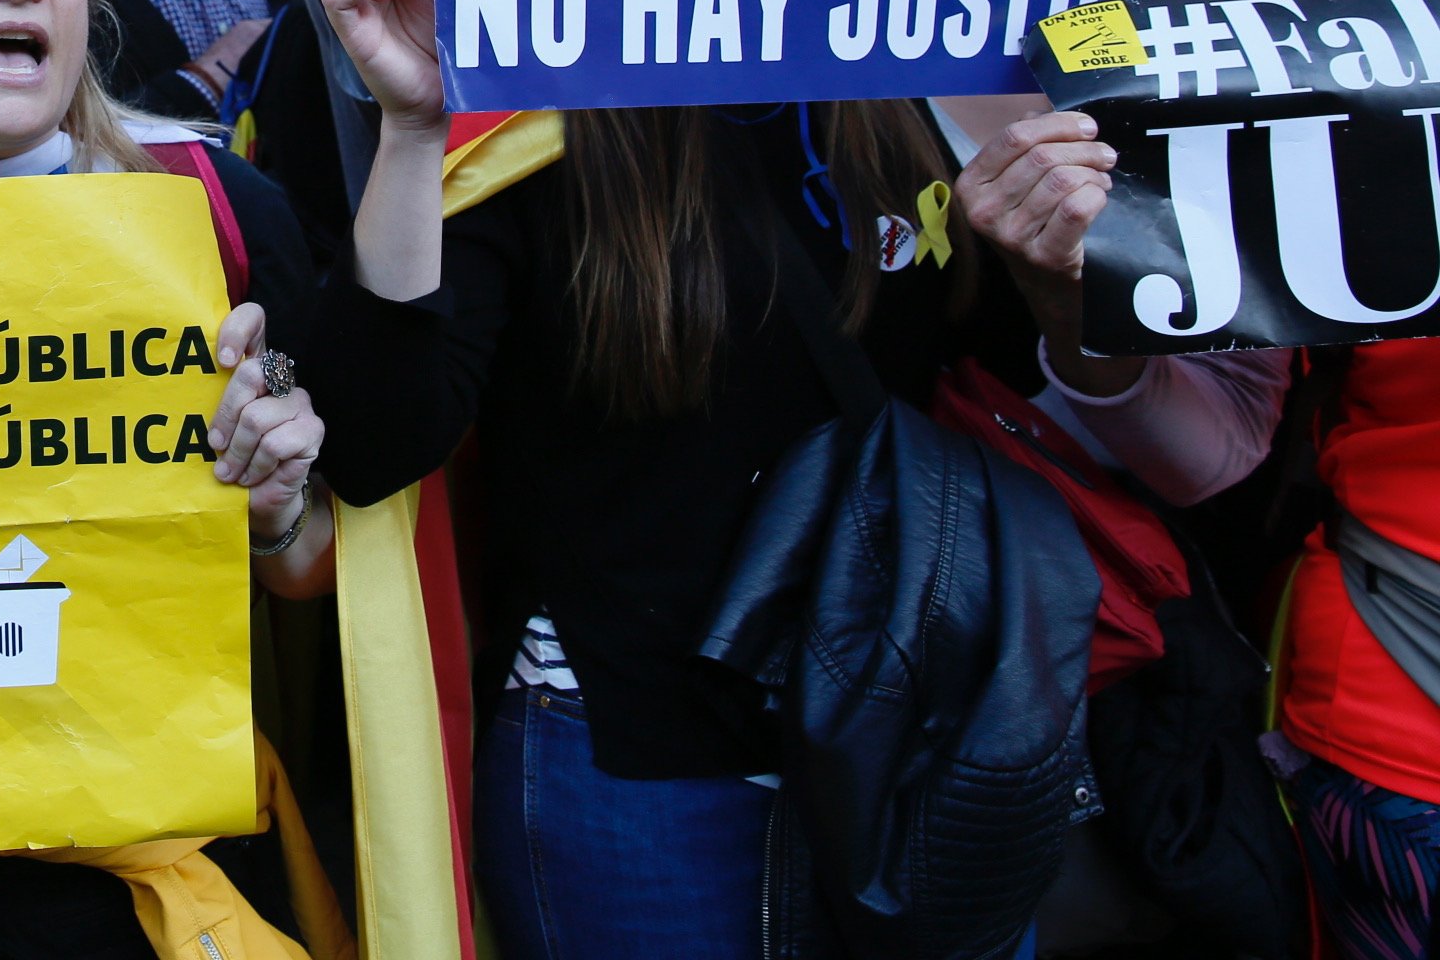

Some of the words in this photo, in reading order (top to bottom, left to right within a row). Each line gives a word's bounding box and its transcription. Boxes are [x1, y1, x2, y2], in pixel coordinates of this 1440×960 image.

[1043, 14, 1066, 27] UN
[1069, 3, 1121, 19] JUDICI
[1079, 15, 1103, 25] TOT
[1092, 48, 1110, 56] UN
[1080, 55, 1129, 67] POBLE
